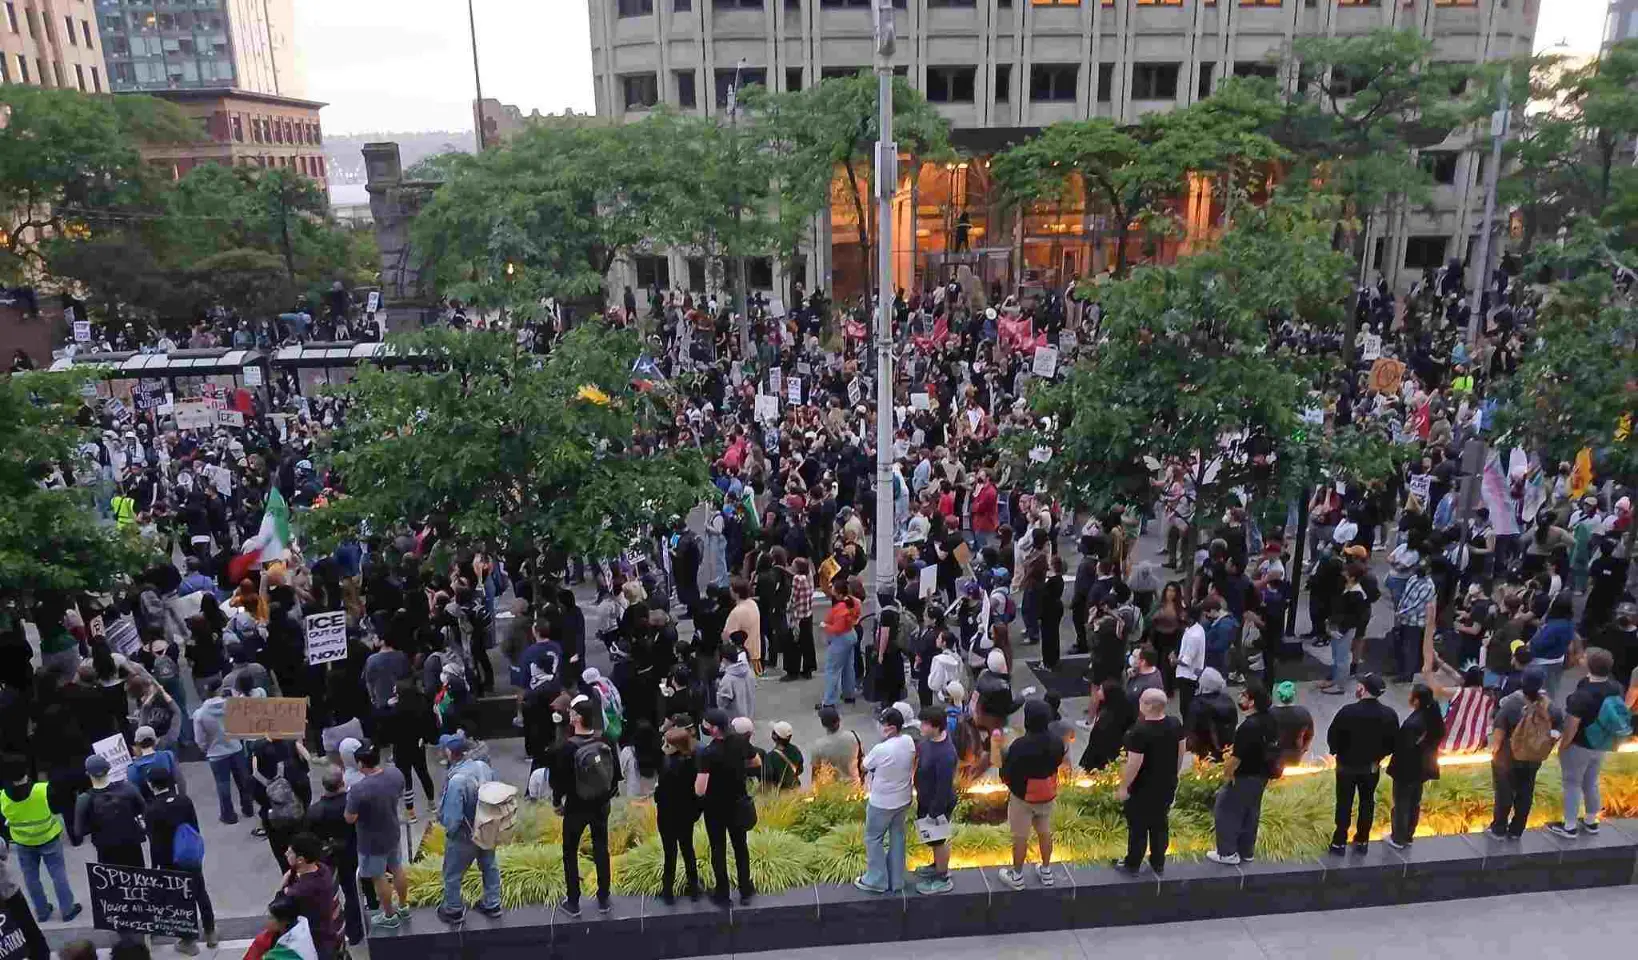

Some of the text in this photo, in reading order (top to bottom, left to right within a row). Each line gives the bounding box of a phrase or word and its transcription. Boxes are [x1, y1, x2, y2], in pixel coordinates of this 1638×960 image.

[309, 614, 345, 630] ICE
[310, 648, 346, 661] NOW
[119, 886, 149, 902] ICE
